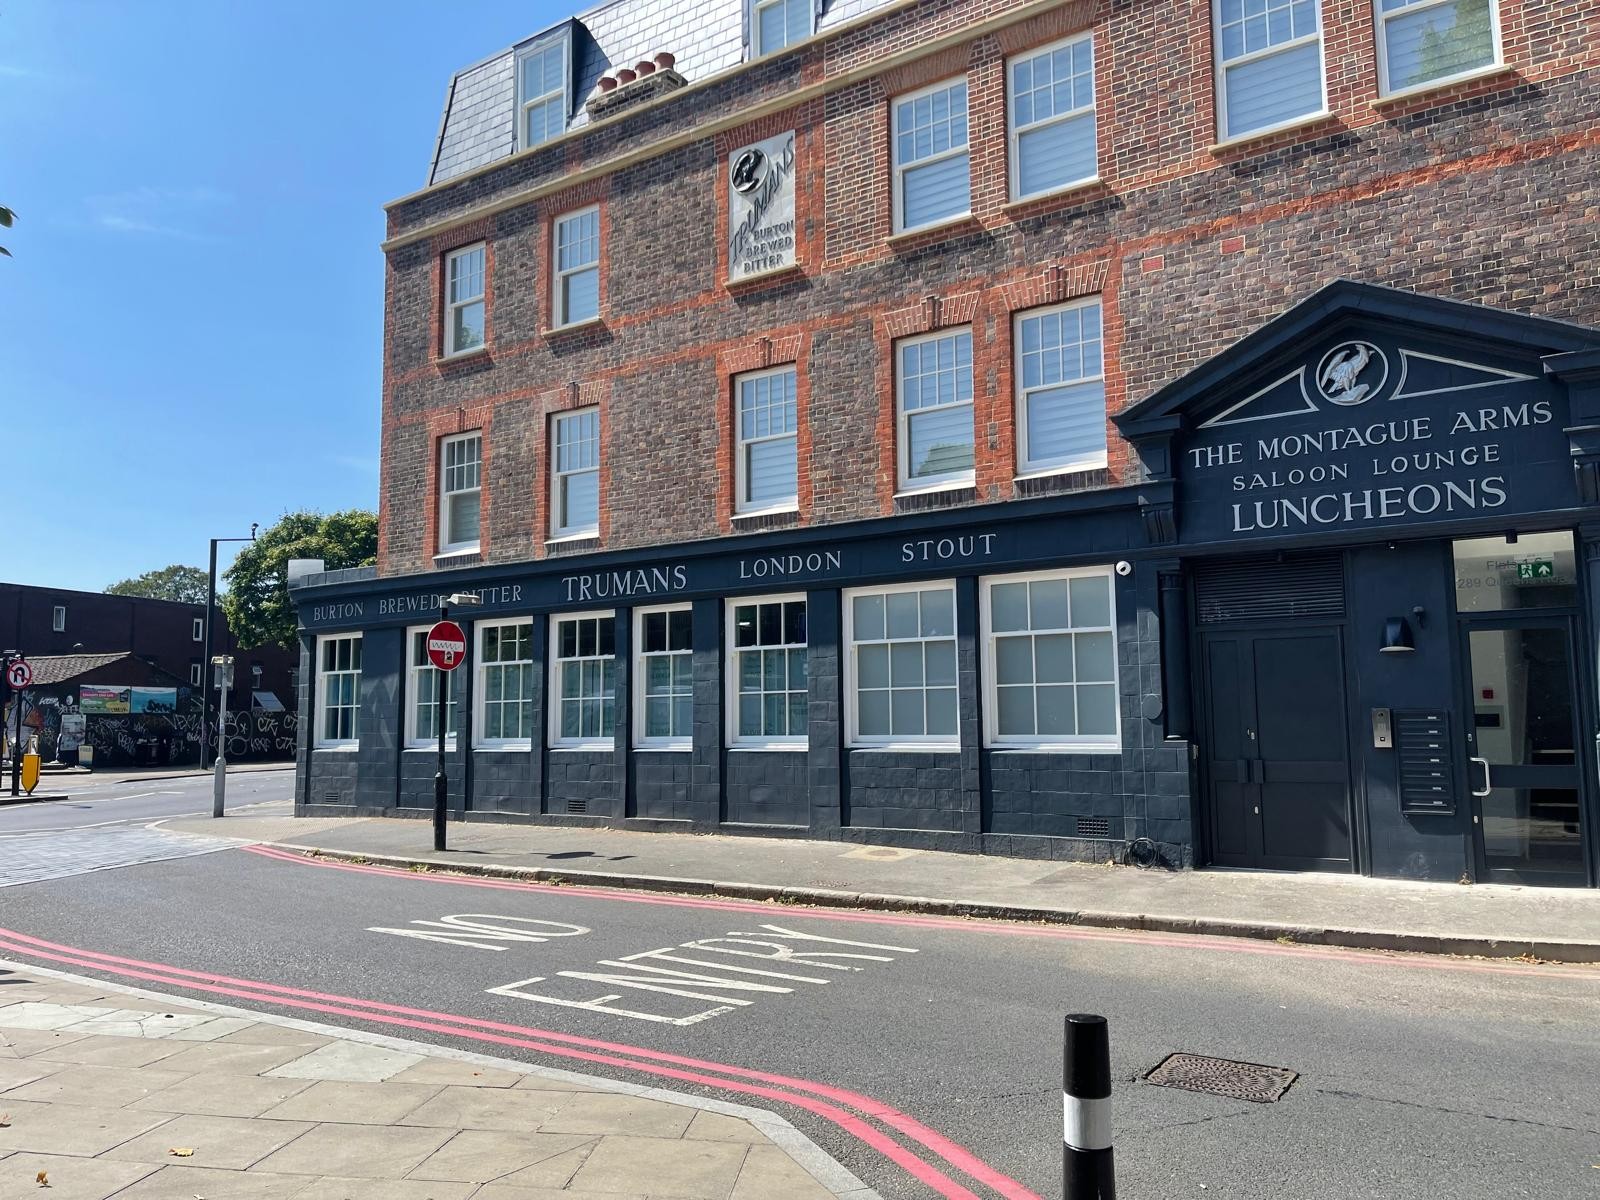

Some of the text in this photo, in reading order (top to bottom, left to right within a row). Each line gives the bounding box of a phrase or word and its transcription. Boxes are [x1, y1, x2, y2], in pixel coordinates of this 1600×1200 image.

[730, 136, 794, 264] TRUMANS
[746, 236, 792, 258] BREWED
[754, 220, 794, 241] BURTON
[744, 253, 784, 275] BITTER
[1189, 401, 1553, 468] THE MONTAGUE ARMS
[1233, 443, 1500, 491] SALOON LOUNGE
[1232, 475, 1507, 532] LUNCHEONS
[314, 602, 364, 621] BURTON
[379, 594, 441, 615] BREWED
[562, 565, 688, 602] TRUMANS
[739, 550, 842, 579] LONDON
[902, 533, 997, 562] STOUT
[1458, 577, 1481, 589] 289
[363, 914, 590, 951] NO
[485, 924, 920, 1025] ENTRY
